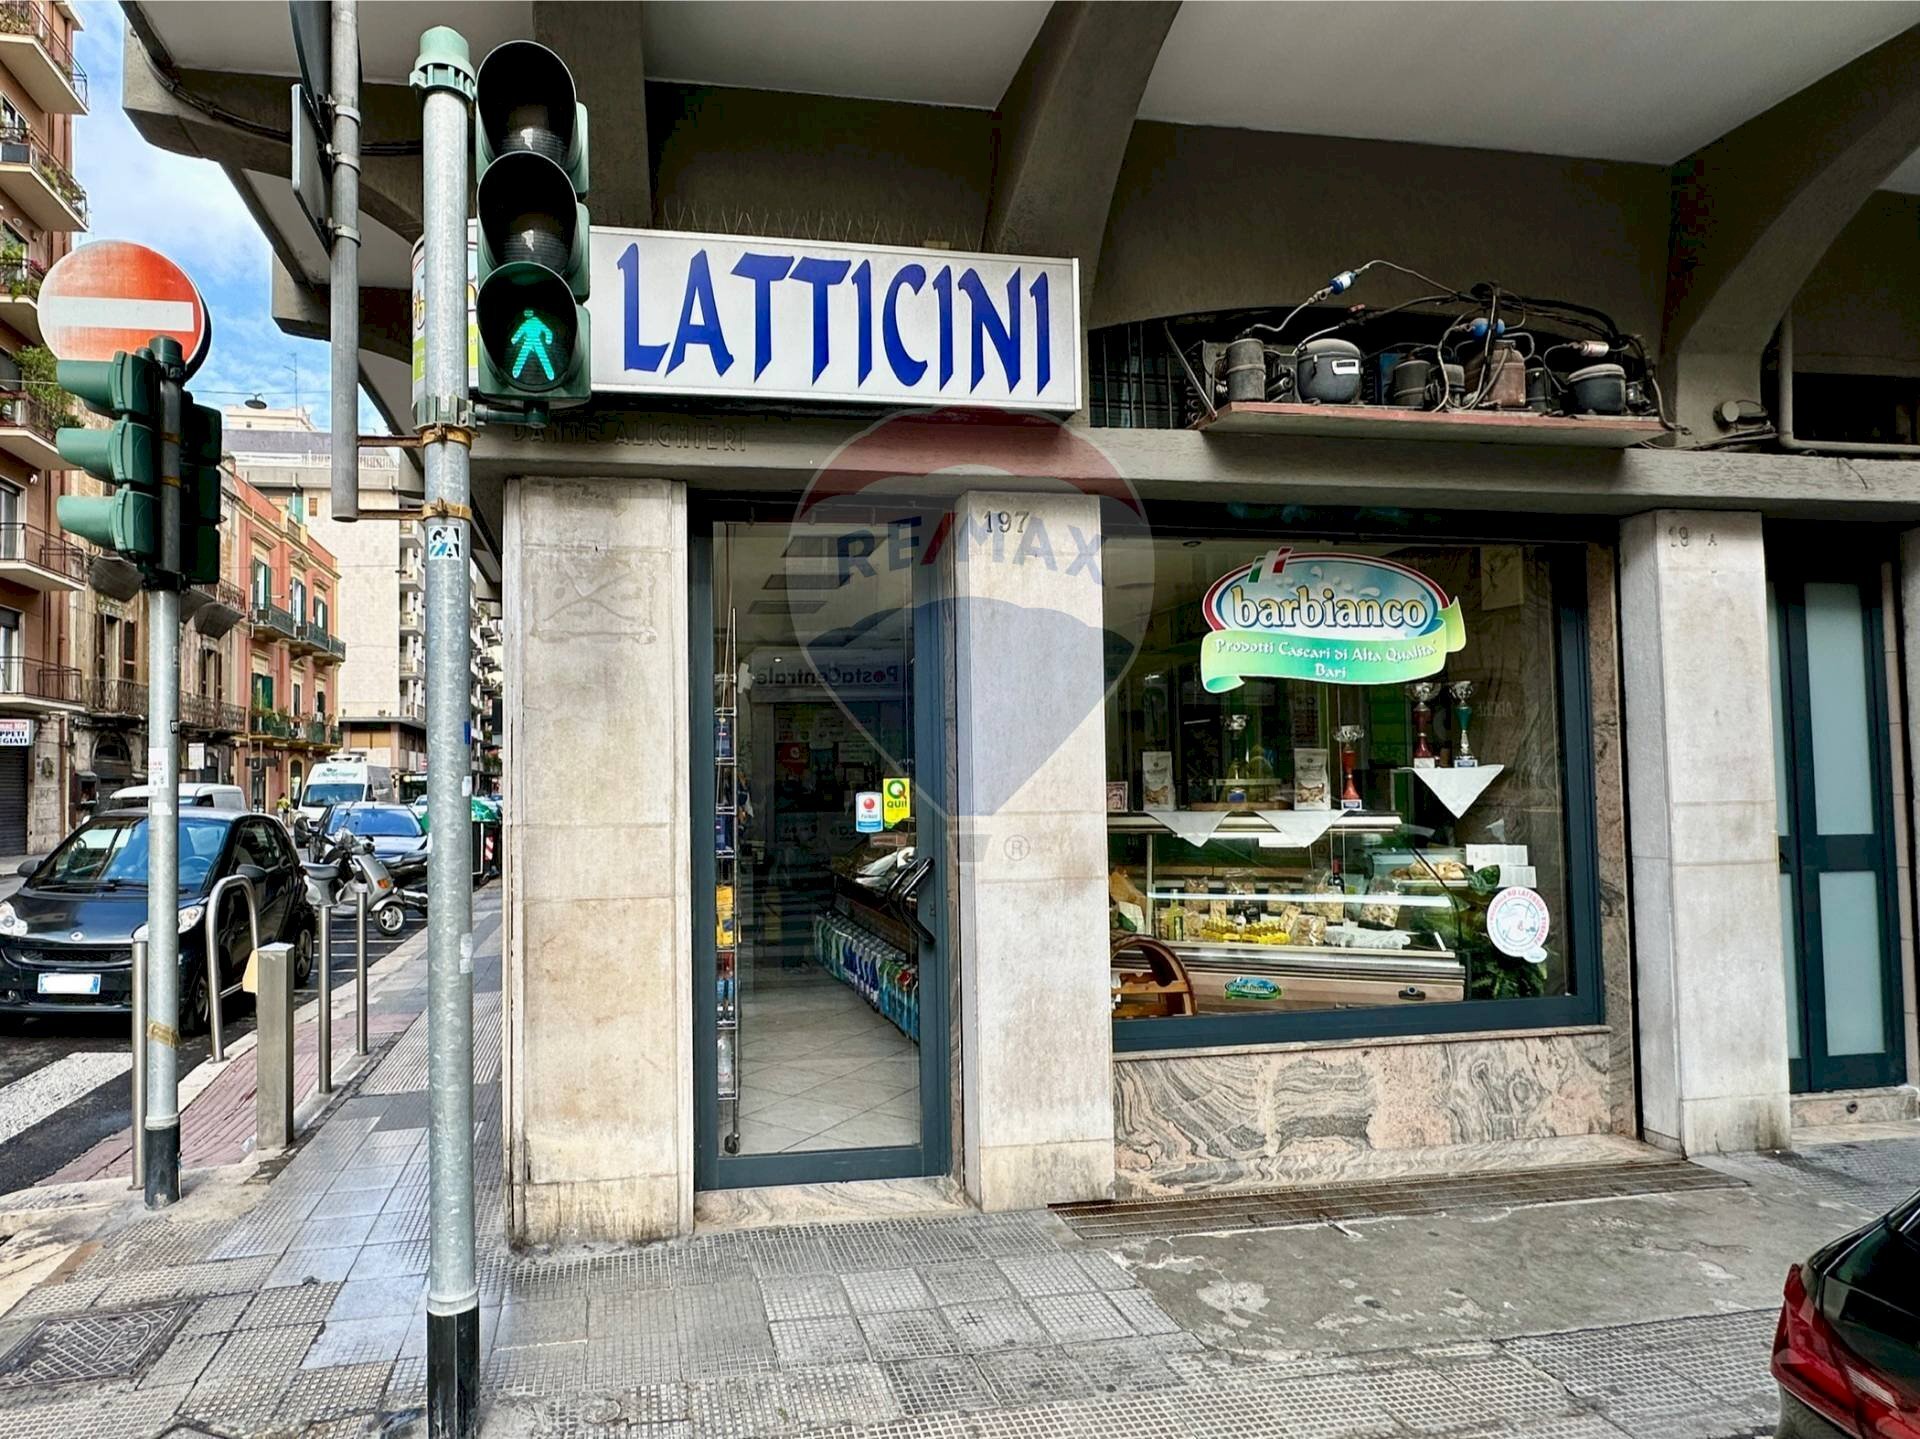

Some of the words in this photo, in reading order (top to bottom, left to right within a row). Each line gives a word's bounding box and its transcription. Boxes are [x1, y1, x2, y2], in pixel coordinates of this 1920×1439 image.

[616, 242, 1051, 397] LATTICINI
[613, 421, 747, 451] ALIGHIERI
[983, 510, 1030, 534] 197
[1231, 585, 1428, 629] barbianco
[1215, 638, 1274, 654] Prodotti
[1278, 641, 1331, 660] Cascari
[1334, 648, 1348, 660] di
[1352, 647, 1382, 662] Alta
[1315, 663, 1347, 679] Bari
